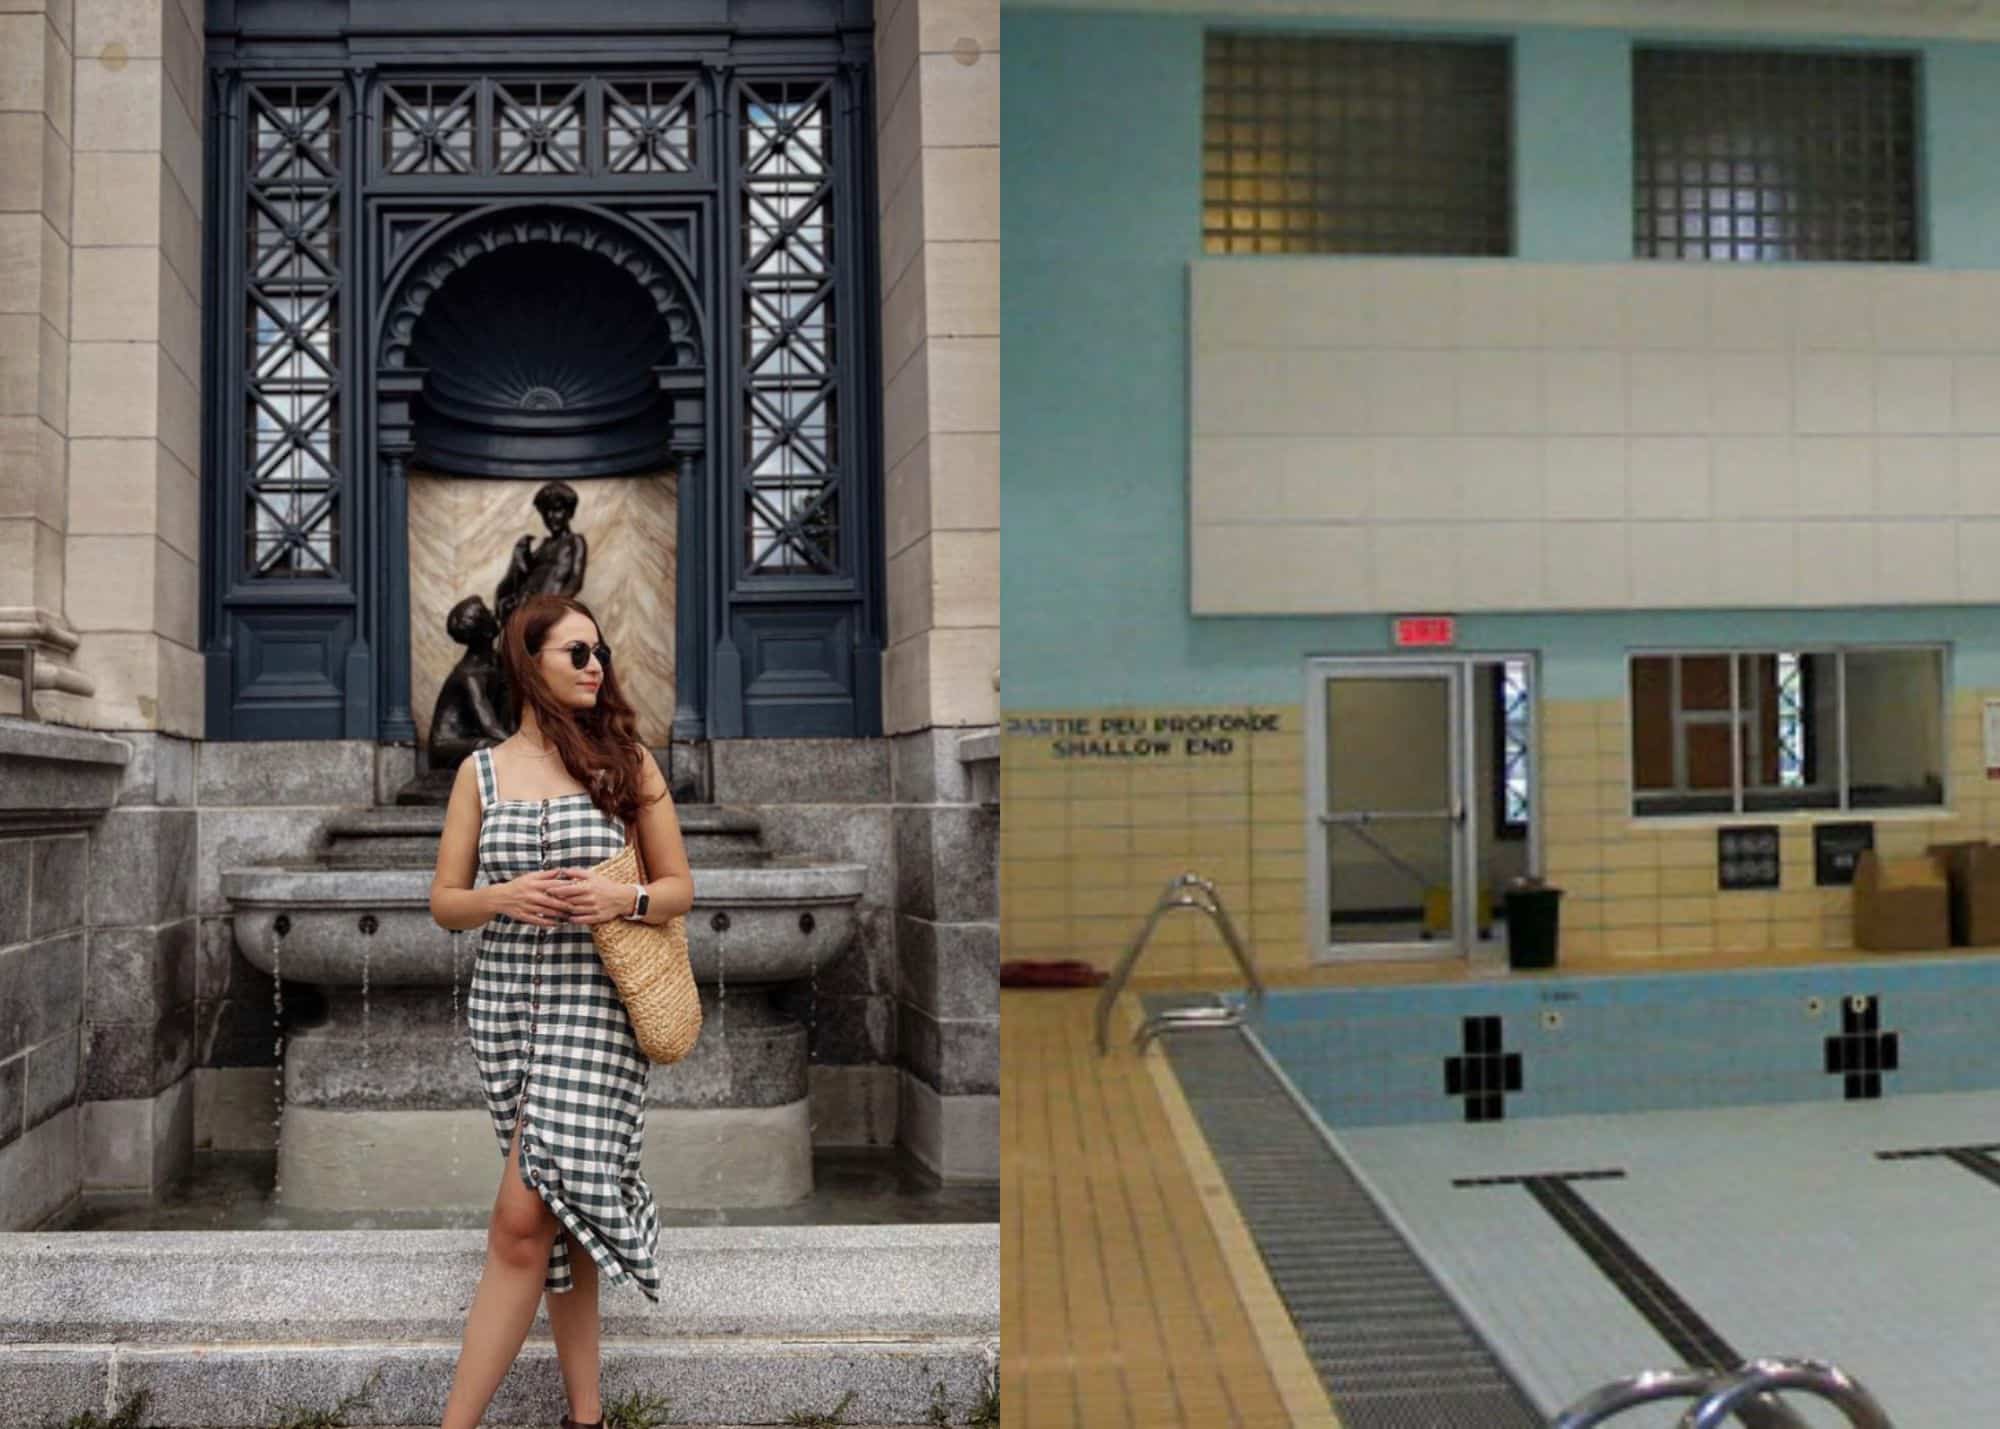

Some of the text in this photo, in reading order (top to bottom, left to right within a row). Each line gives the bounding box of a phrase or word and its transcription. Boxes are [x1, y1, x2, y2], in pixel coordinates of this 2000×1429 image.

[1007, 714, 1280, 736] PARTIE PEU PROFONDE
[1052, 737, 1235, 757] SHALLOW END
